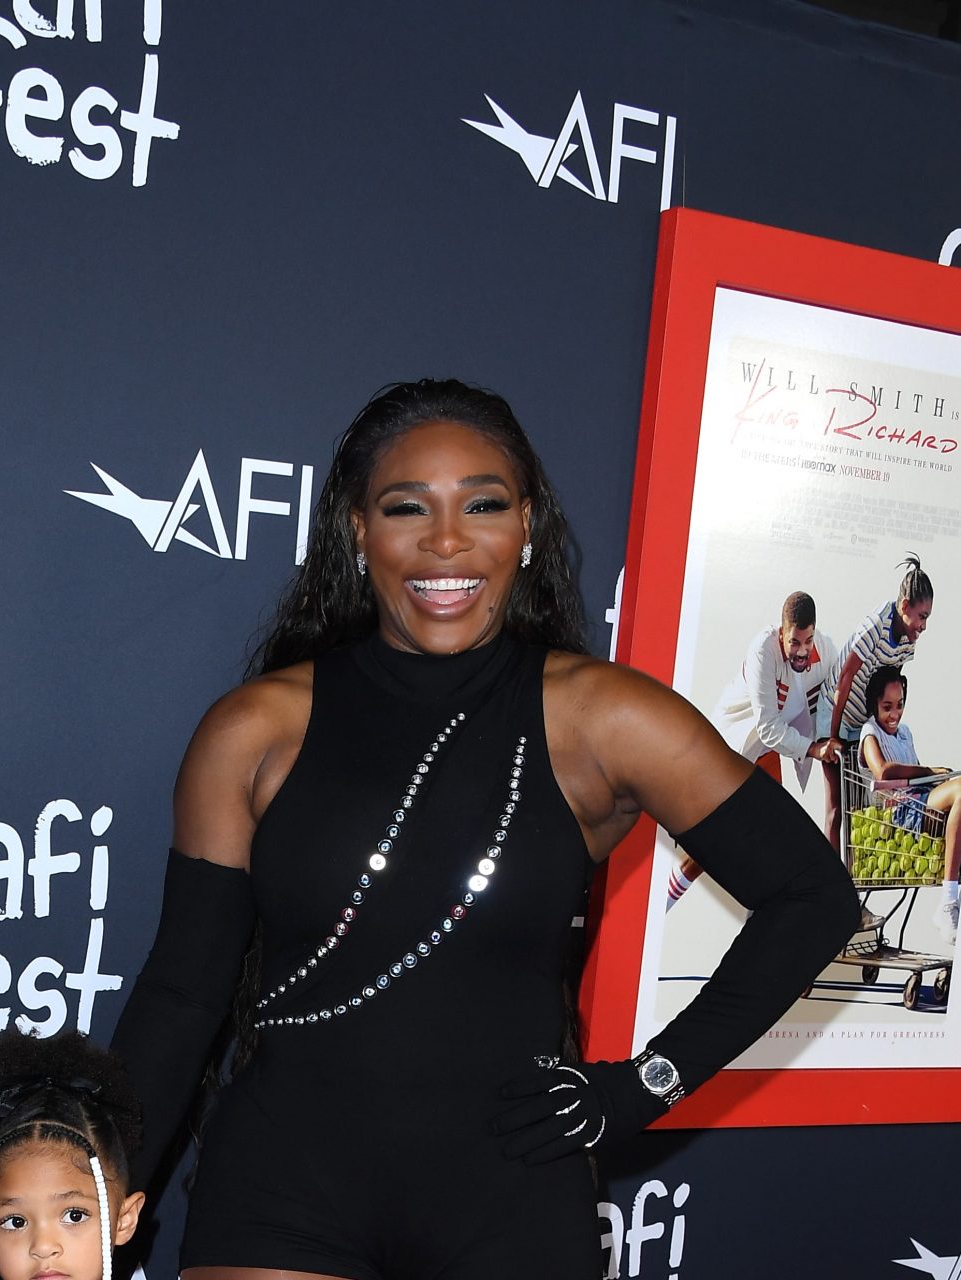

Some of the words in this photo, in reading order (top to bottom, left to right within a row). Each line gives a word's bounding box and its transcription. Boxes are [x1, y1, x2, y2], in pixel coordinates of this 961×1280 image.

[538, 88, 677, 213] AFI
[741, 361, 819, 395] WILL
[848, 382, 945, 418] SMITH
[824, 388, 958, 453] RICHARD
[839, 464, 881, 481] NOVEMBER
[846, 448, 864, 457] THAT
[866, 451, 882, 461] WILL
[884, 455, 911, 466] INSPIRE
[913, 459, 927, 469] THE
[929, 462, 953, 473] WORLD
[153, 447, 314, 566] AFI
[806, 1031, 824, 1039] AND
[841, 1031, 865, 1039] PLAN
[870, 1031, 887, 1039] FOR
[893, 1031, 946, 1039] GREATNESS
